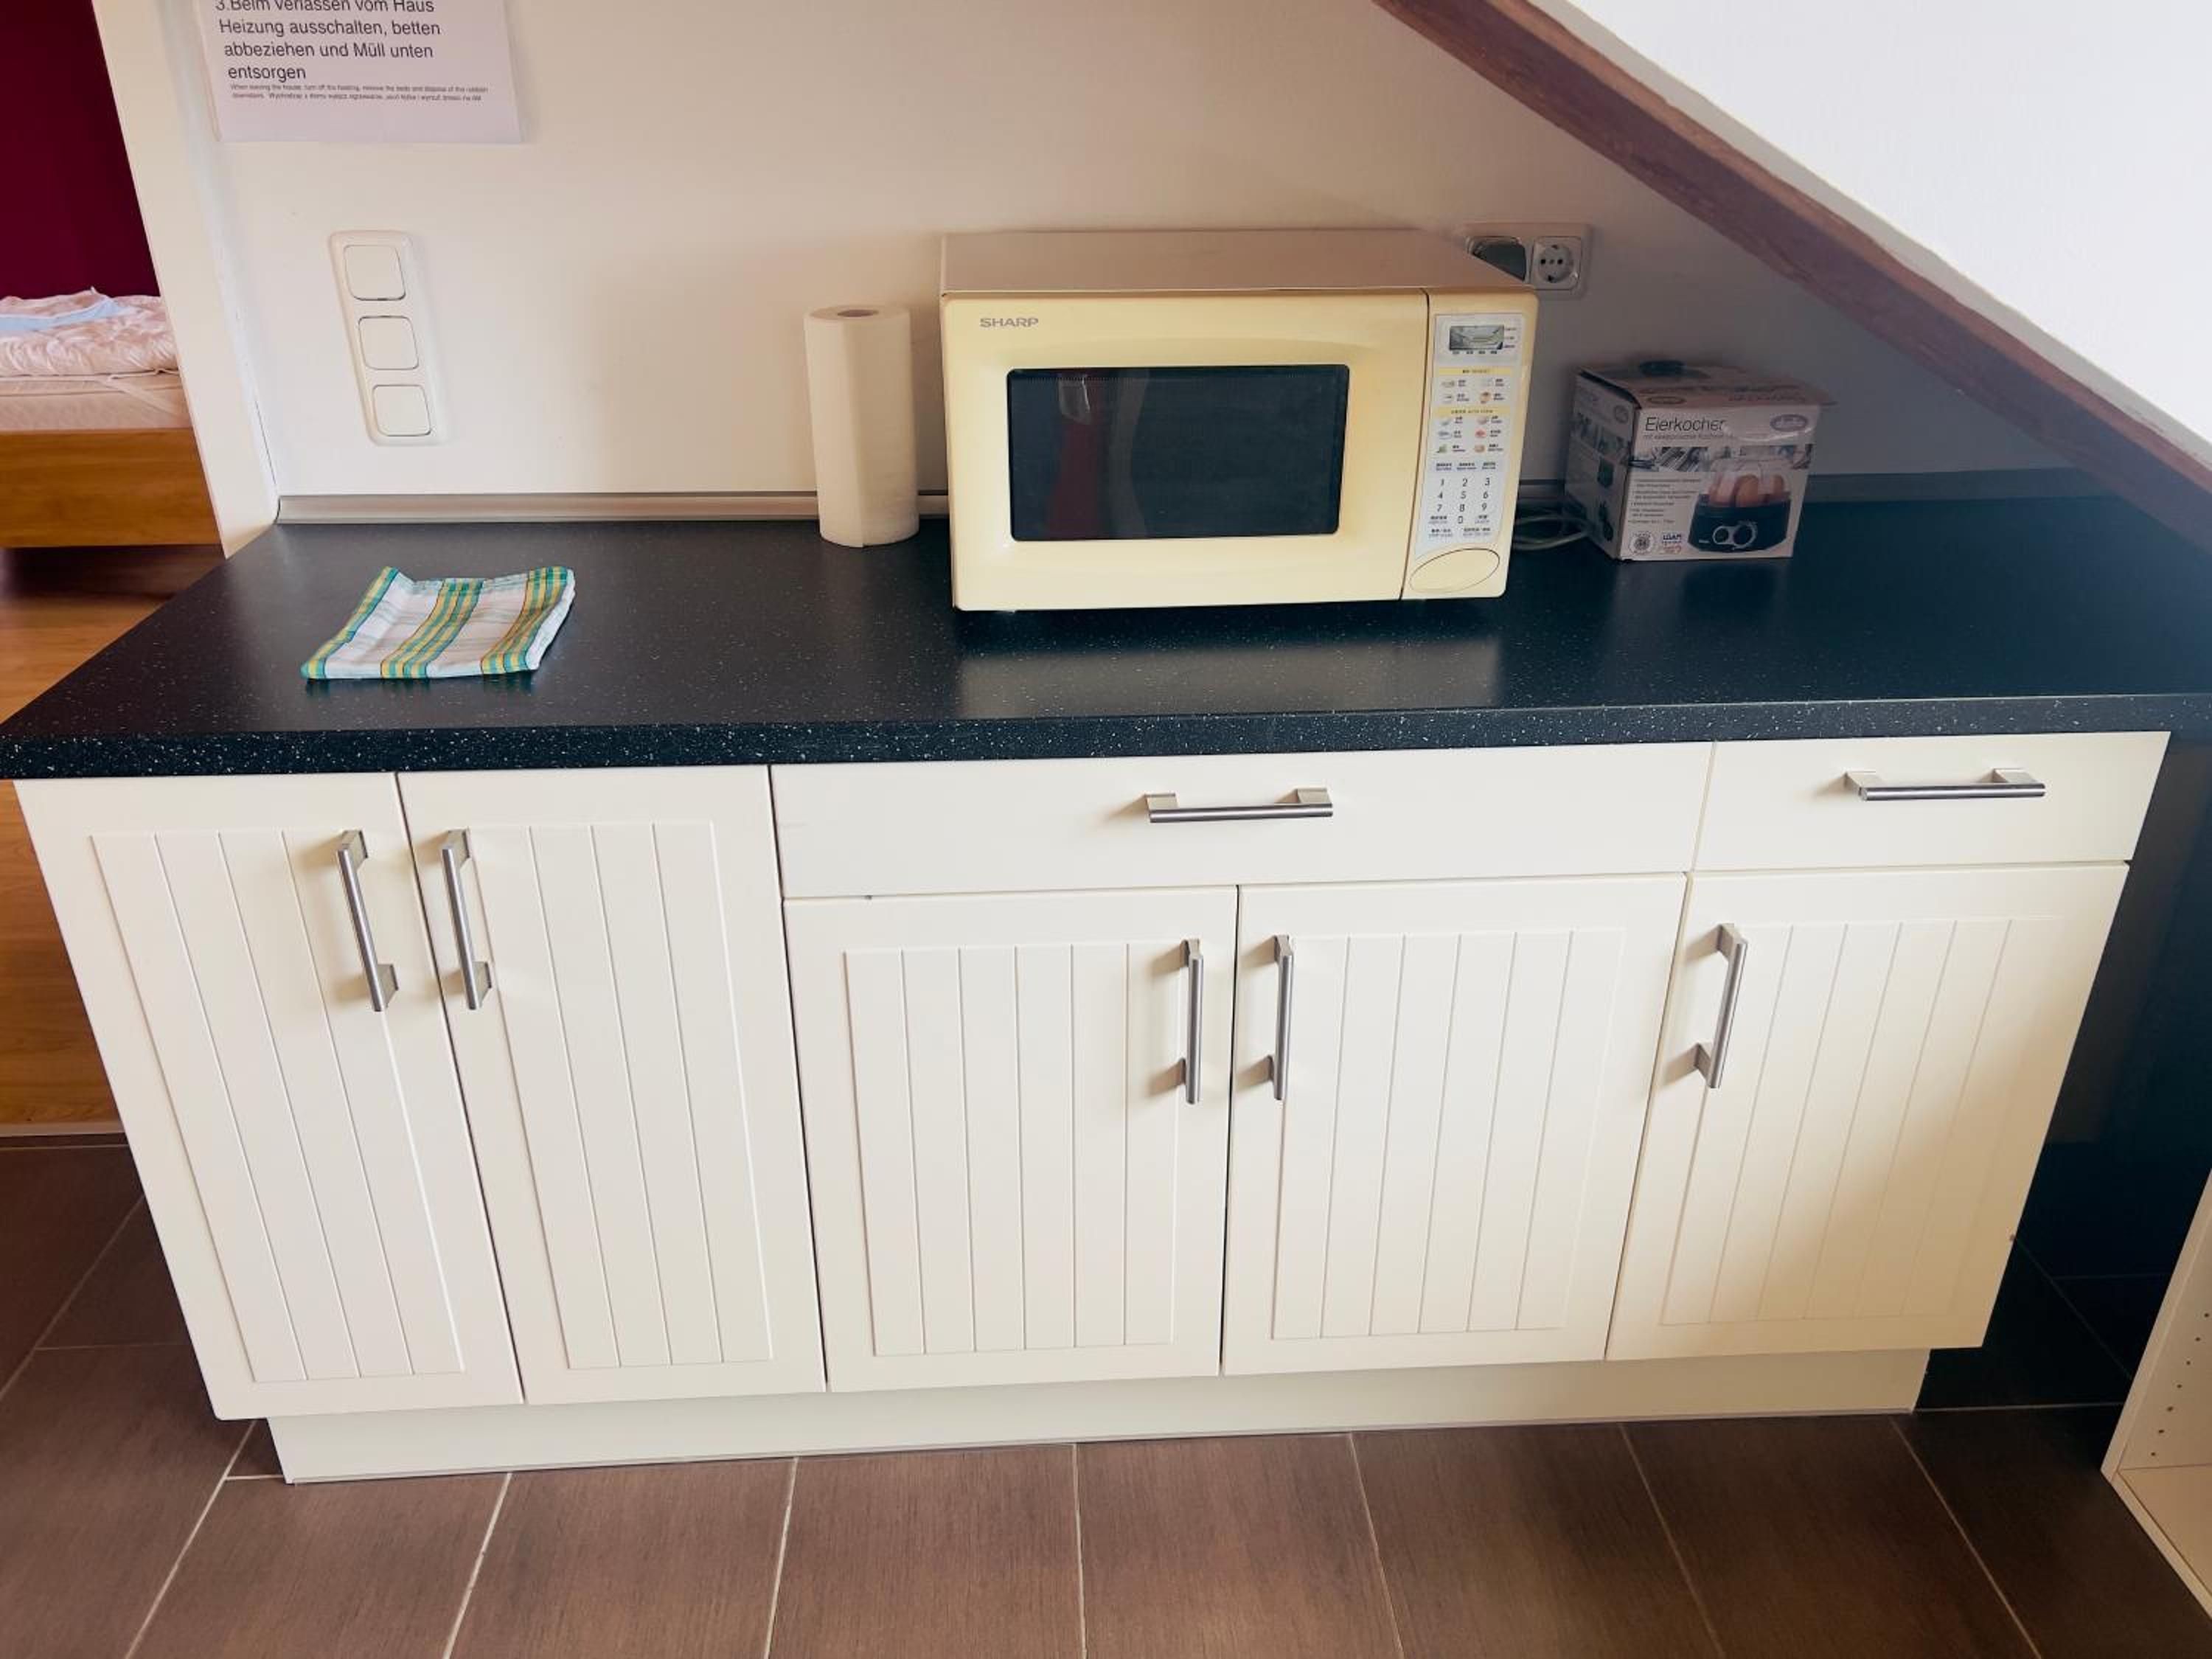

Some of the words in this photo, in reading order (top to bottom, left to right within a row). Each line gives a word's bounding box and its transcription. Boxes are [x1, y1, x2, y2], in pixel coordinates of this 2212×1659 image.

[355, 0, 389, 12] vom
[393, 0, 434, 13] Haus
[219, 18, 285, 38] Heizung
[290, 18, 387, 38] ausschalten,
[392, 19, 441, 35] betten
[224, 42, 314, 57] abbeziehen
[319, 43, 349, 57] und
[353, 42, 386, 58] Müll
[390, 44, 433, 58] unten
[227, 66, 307, 83] entsorgen
[979, 317, 1039, 328] SHARP
[1645, 416, 1725, 432] Eierkocher
[1462, 477, 1468, 487] 2
[1484, 477, 1490, 486] 3
[1437, 491, 1443, 499] 4
[1460, 490, 1467, 499] 5
[1483, 490, 1489, 499] 6
[1436, 504, 1442, 512] 7
[1459, 504, 1465, 512] 8
[1481, 502, 1487, 511] 9
[1458, 515, 1464, 524] 0
